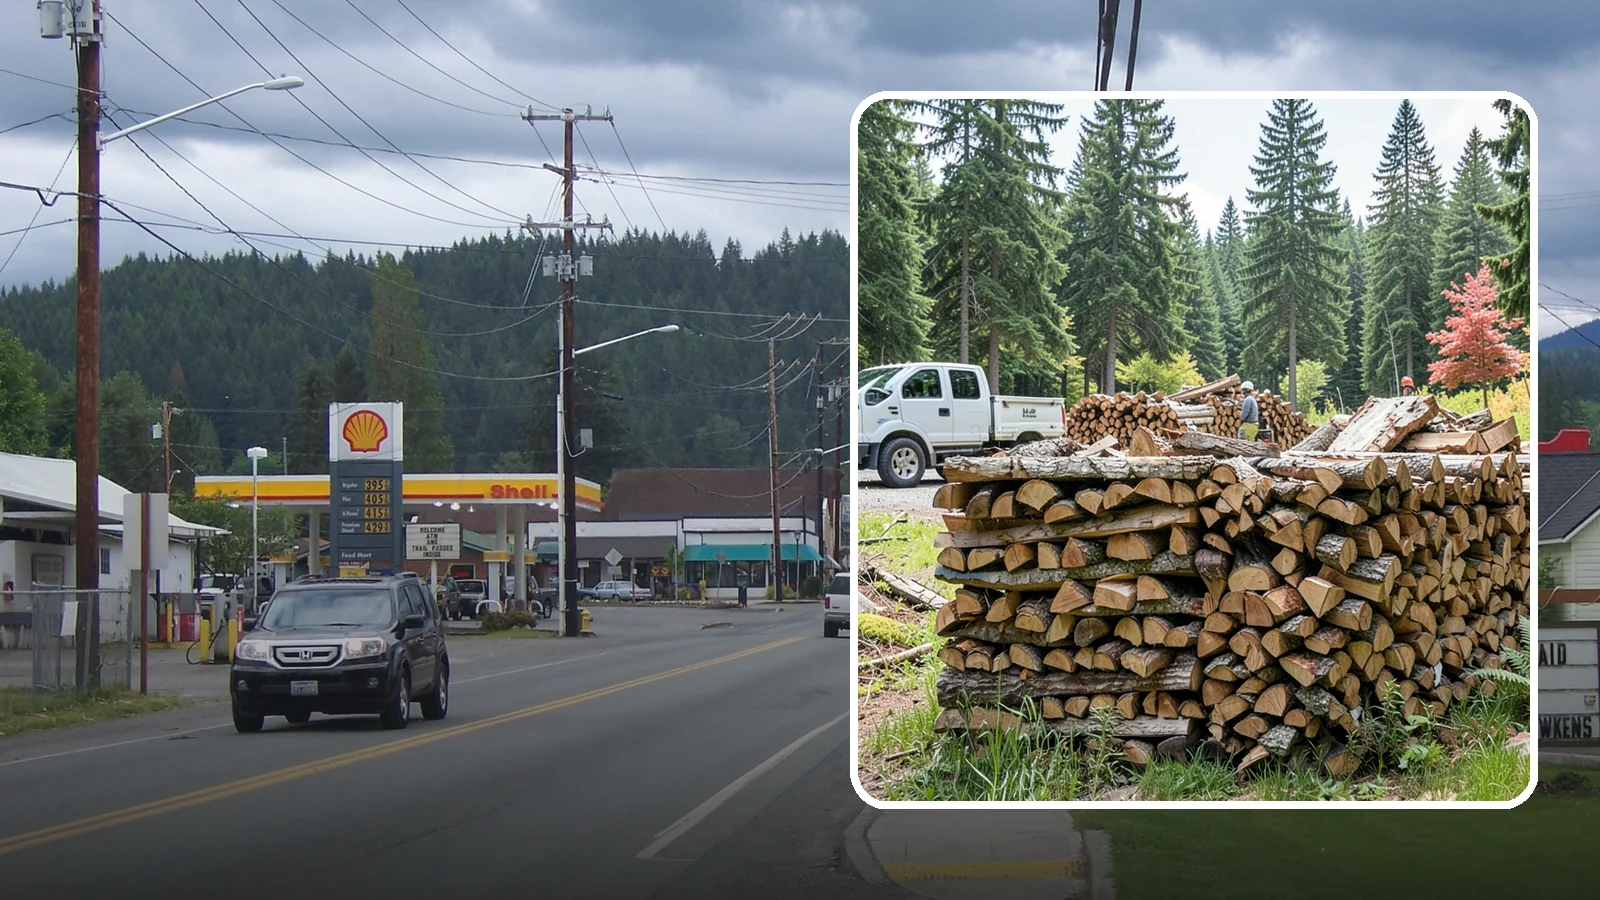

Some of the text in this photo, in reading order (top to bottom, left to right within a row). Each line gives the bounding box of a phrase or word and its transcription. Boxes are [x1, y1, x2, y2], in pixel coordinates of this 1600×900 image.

[366, 480, 384, 490] 395
[490, 484, 547, 499] Shell
[365, 494, 384, 504] 405
[365, 508, 384, 518] 415
[365, 522, 384, 532] 429
[1538, 643, 1567, 666] AID
